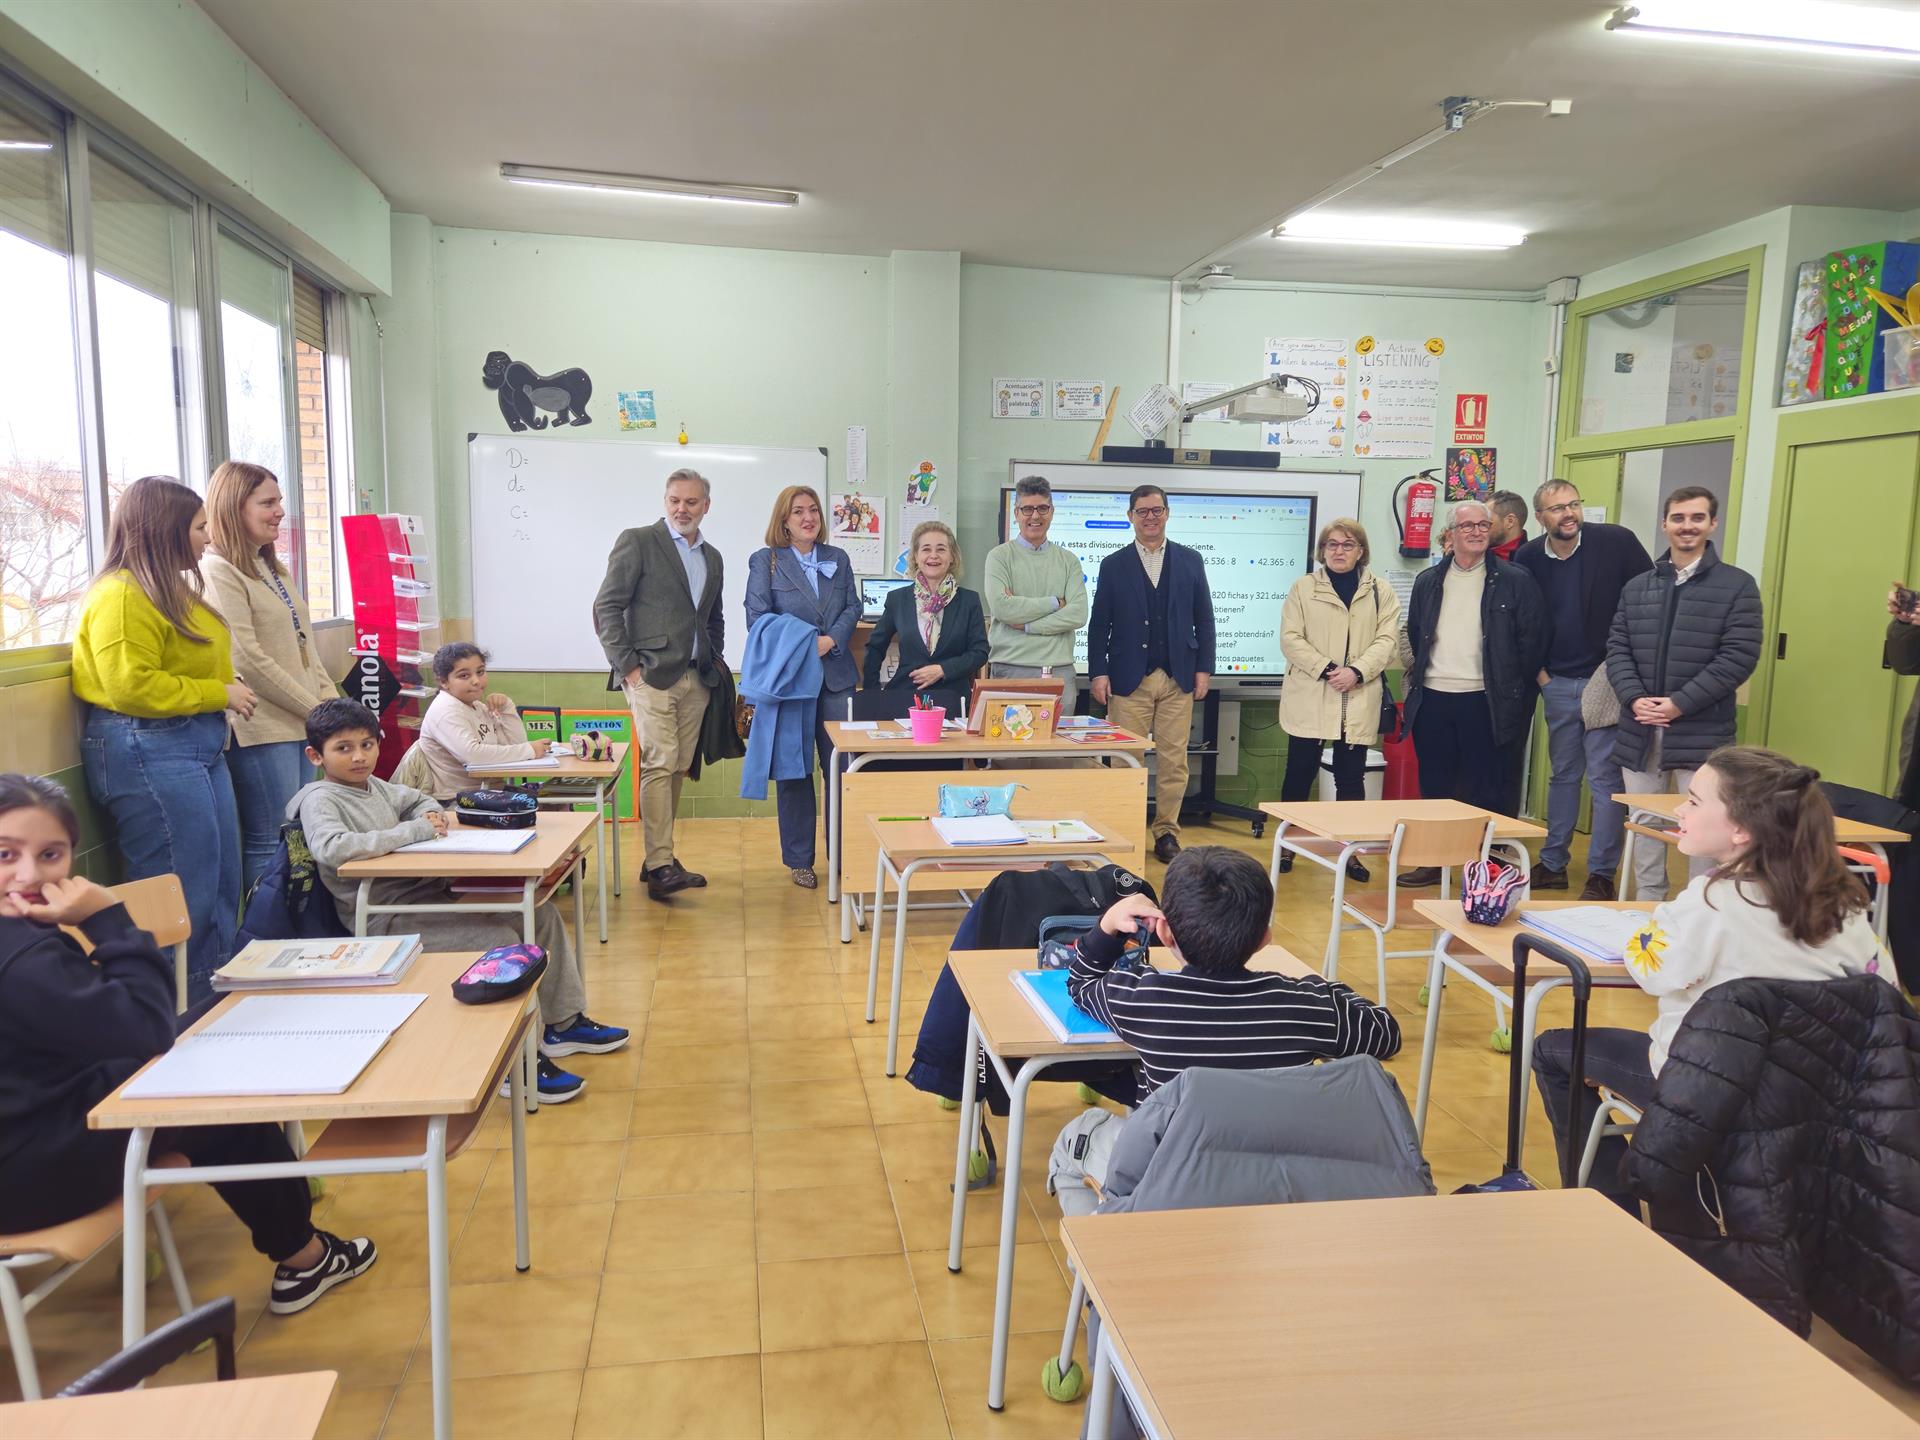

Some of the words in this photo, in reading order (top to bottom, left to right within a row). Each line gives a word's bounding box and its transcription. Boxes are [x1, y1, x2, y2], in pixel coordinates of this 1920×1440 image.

[1839, 310, 1873, 336] MEJOR
[1388, 343, 1417, 353] Active
[1364, 354, 1431, 367] LISTENING
[1455, 433, 1484, 441] EXTINTOR
[1257, 558, 1285, 567] 42.365
[1211, 591, 1226, 600] 820
[1227, 591, 1248, 600] fichas
[1256, 591, 1270, 600] 321
[1233, 630, 1275, 638] obtendrán?
[528, 721, 554, 730] MES
